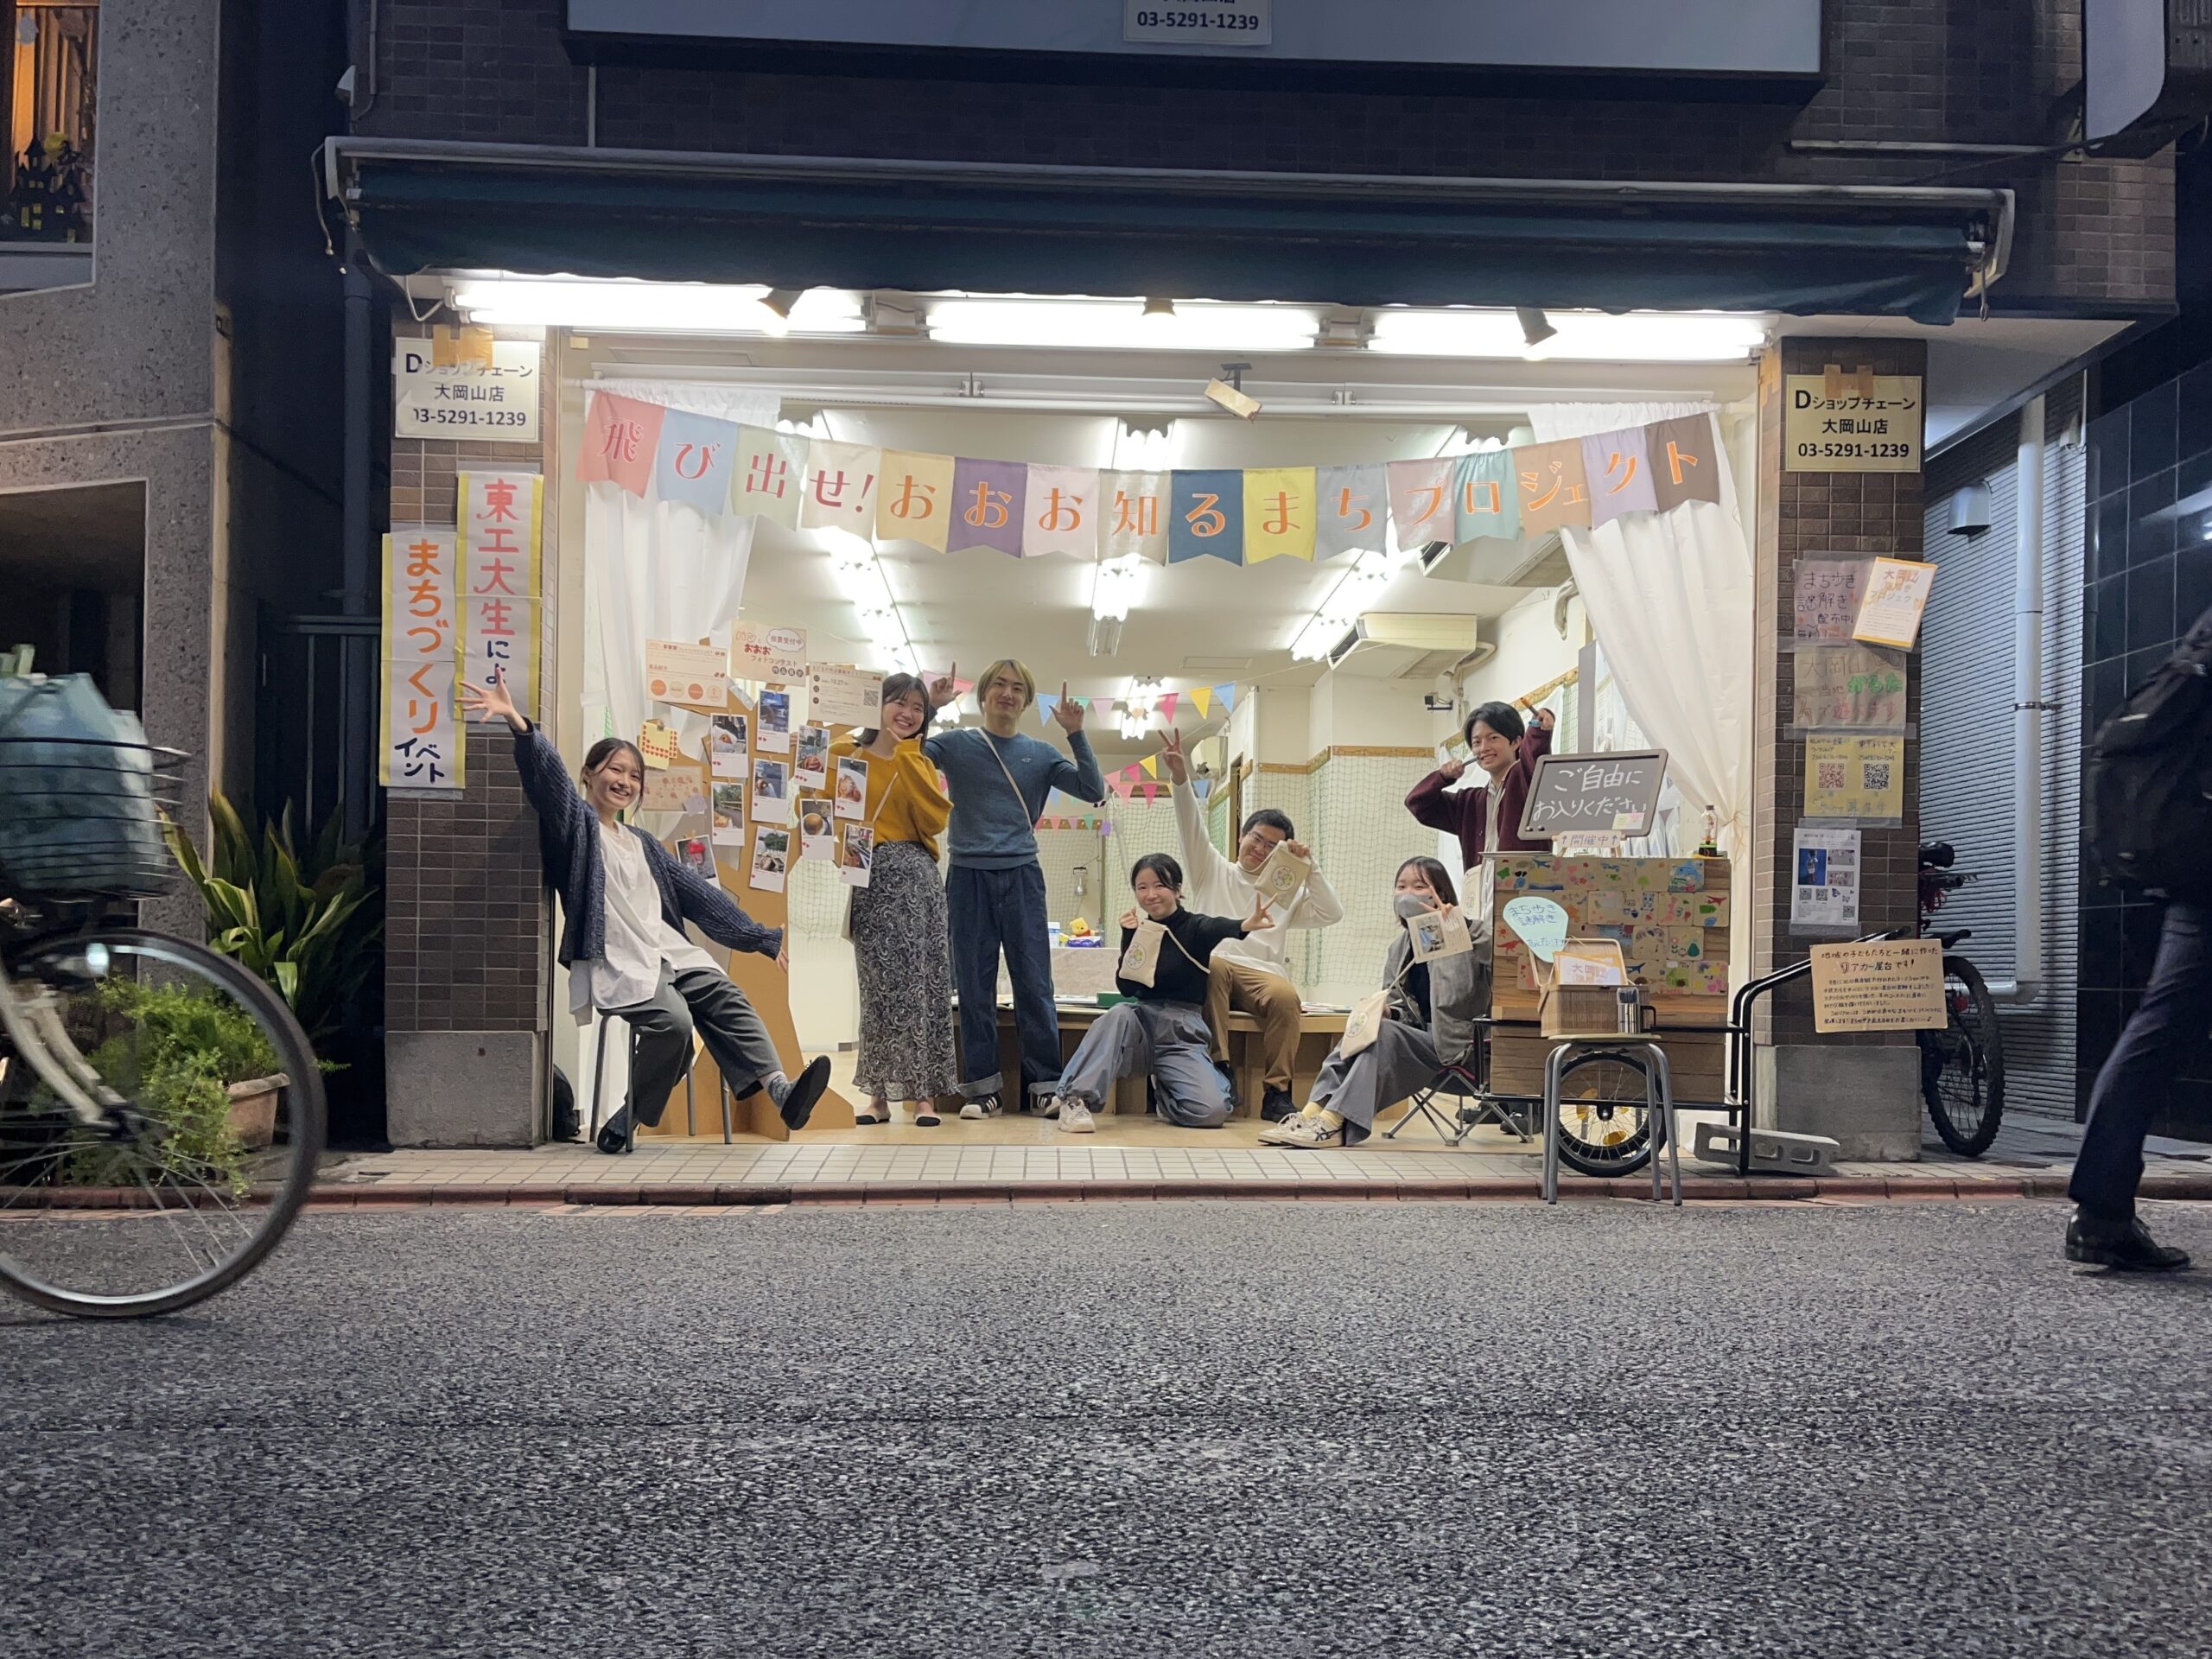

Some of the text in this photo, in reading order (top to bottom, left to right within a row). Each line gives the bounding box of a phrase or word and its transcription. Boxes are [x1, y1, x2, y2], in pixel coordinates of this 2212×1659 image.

[1137, 11, 1259, 30] 03-5291-1239
[435, 384, 505, 403] 大岡山店
[1795, 390, 1916, 410] Dショップチェーン
[1821, 418, 1889, 435] 大岡山店
[1798, 442, 1910, 458] 03-5291-1239
[473, 477, 520, 686] 東工大生によ
[1554, 763, 1644, 792] ご自由に
[1532, 796, 1647, 821] お入りください
